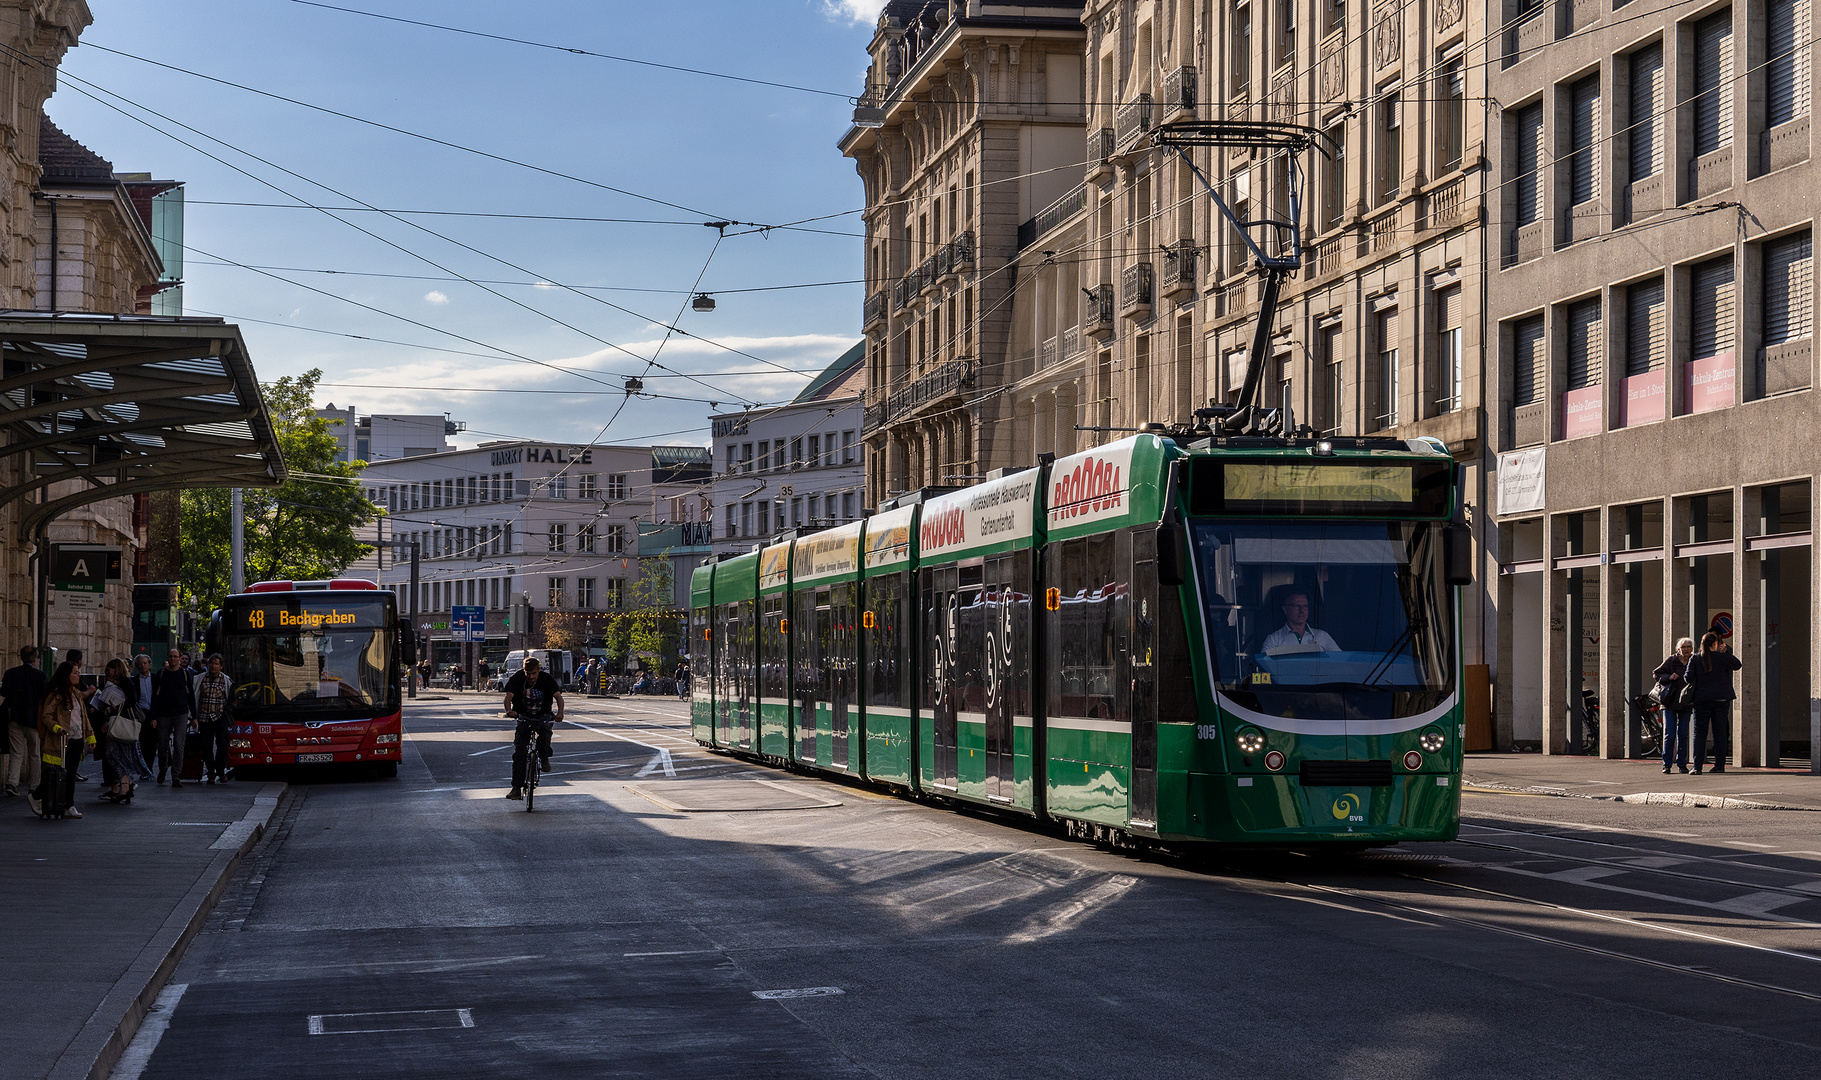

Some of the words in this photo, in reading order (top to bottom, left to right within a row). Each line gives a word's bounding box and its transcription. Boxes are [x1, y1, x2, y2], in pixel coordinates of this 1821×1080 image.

[491, 448, 522, 466] MARKT
[527, 448, 592, 465] HALLE
[782, 486, 793, 496] 35
[1054, 457, 1120, 521] PRODOBA
[922, 500, 965, 551] PRODOBA
[72, 558, 90, 577] A
[249, 609, 264, 628] 48
[280, 609, 355, 626] Bachgraben
[296, 737, 331, 745] MAN
[1197, 724, 1216, 740] 305
